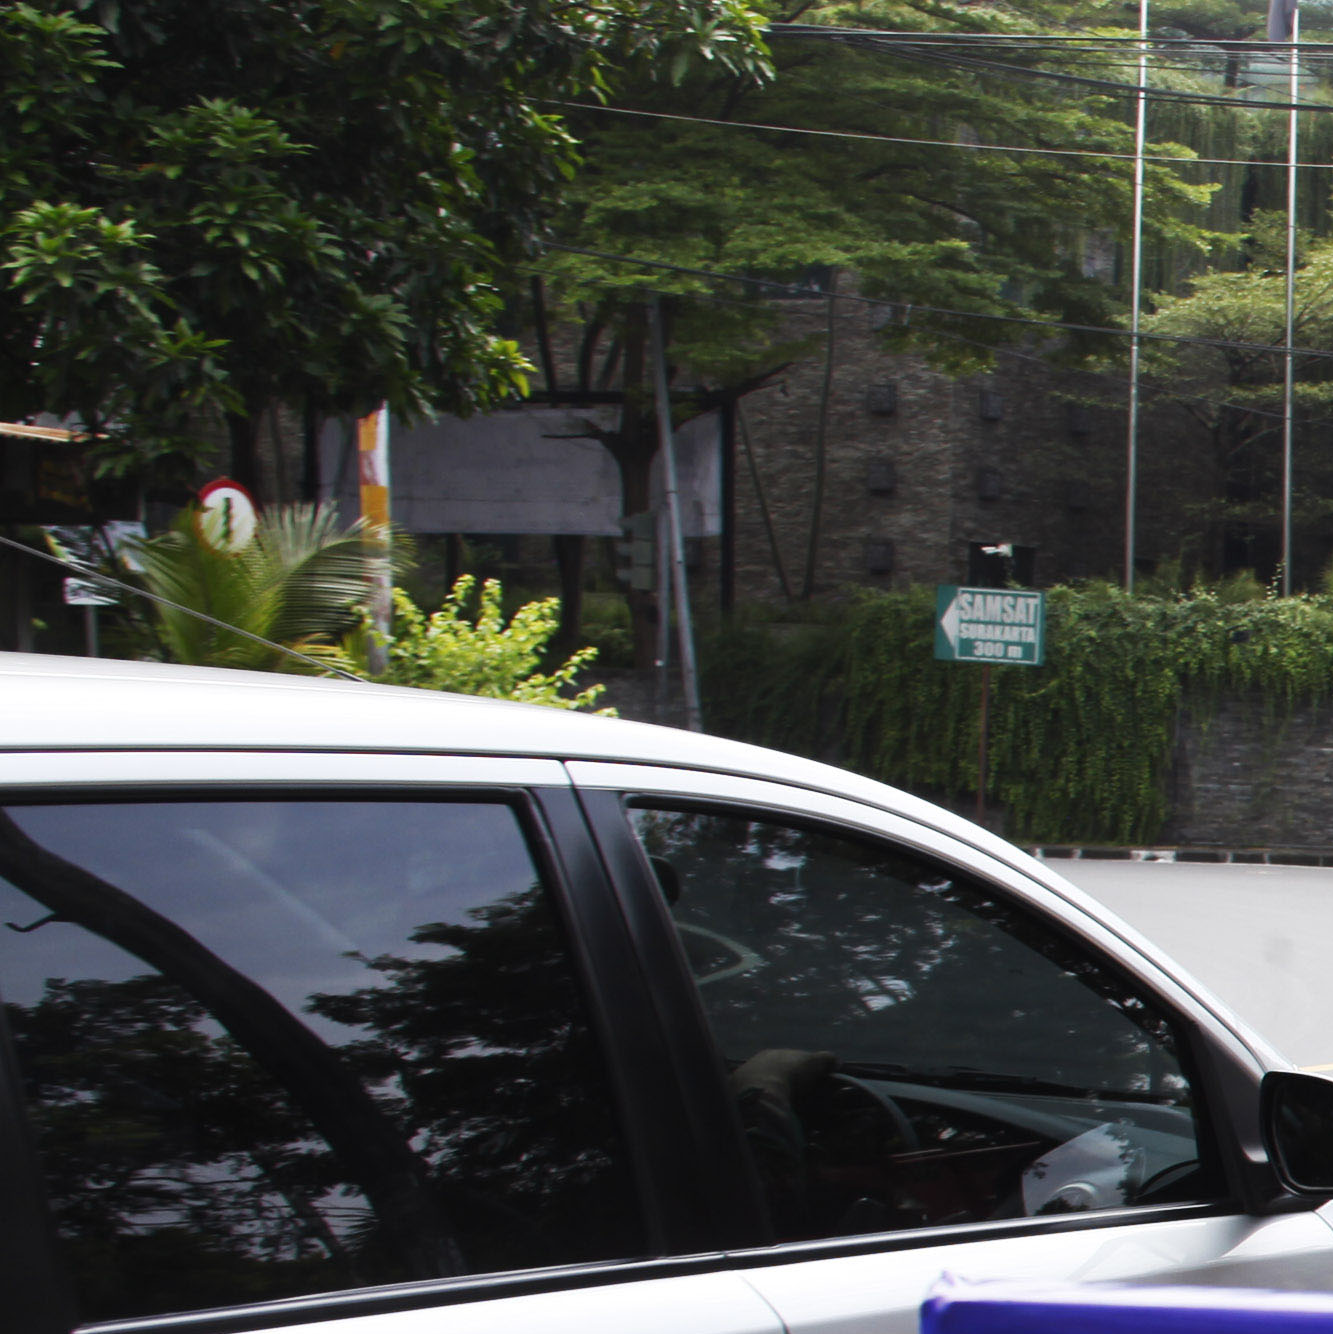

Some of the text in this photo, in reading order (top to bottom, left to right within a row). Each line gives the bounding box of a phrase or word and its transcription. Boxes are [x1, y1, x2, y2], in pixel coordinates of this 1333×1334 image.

[959, 592, 1039, 625] SAMSAT
[959, 622, 1037, 643] SURAKARTA
[973, 640, 1023, 659] 300 m
